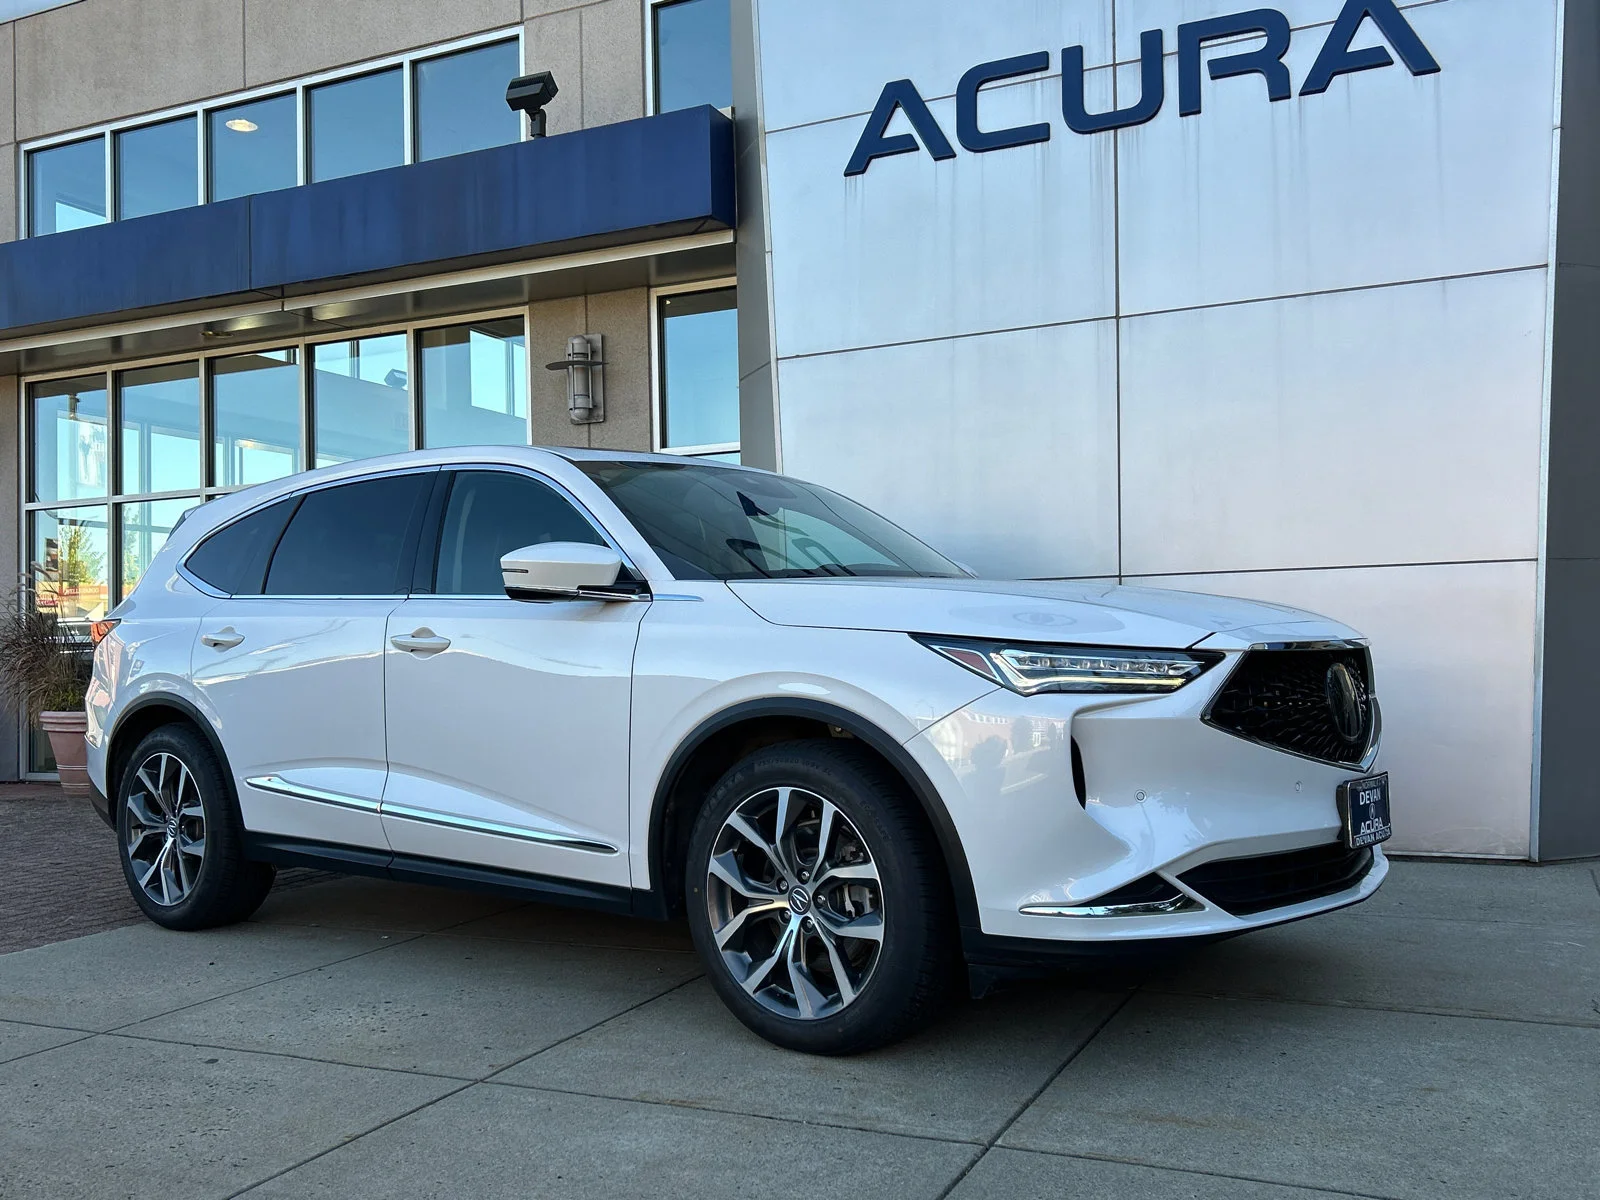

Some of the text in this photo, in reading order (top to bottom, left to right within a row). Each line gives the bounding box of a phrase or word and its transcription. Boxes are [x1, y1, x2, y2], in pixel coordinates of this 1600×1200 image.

[843, 0, 1441, 176] ACURA
[1359, 788, 1381, 806] DEVAN
[1360, 817, 1384, 835] ACURA
